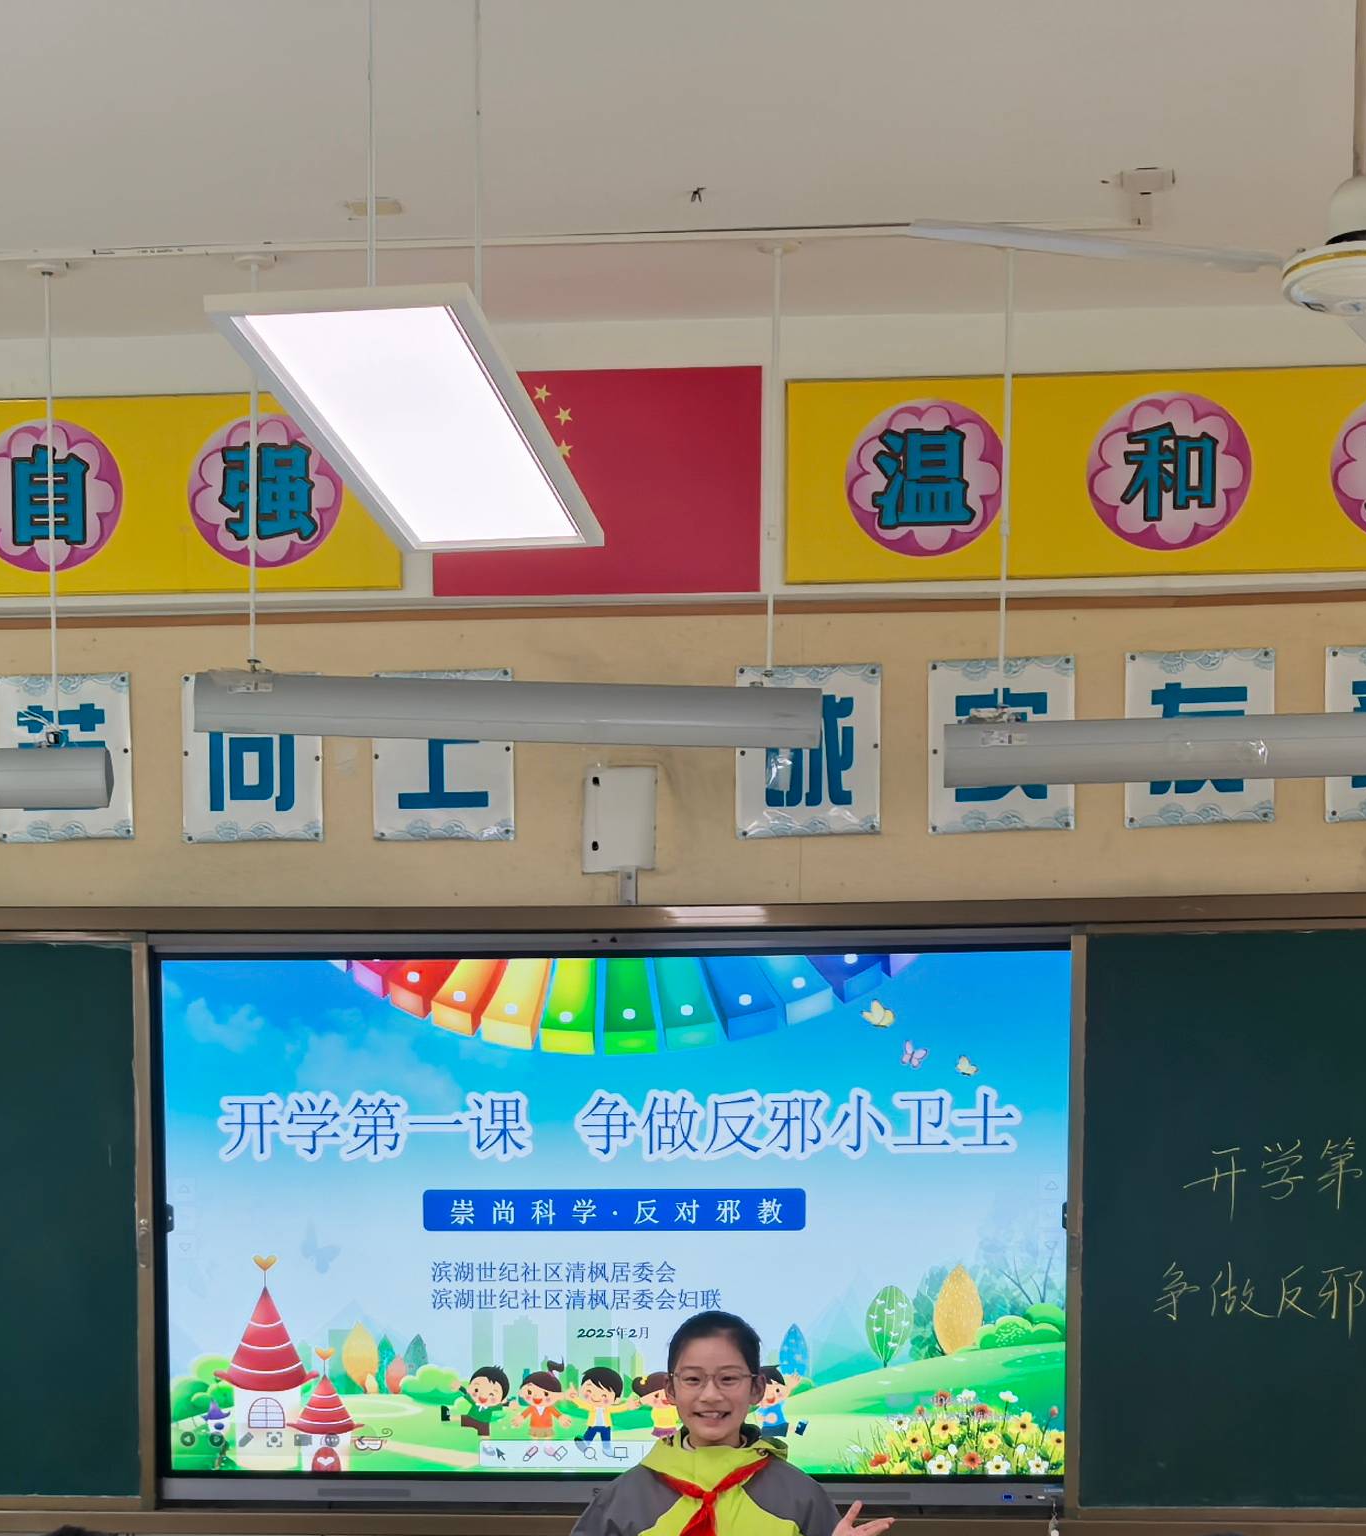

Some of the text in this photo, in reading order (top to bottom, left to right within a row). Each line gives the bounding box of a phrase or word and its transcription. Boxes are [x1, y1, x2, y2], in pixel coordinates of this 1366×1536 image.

[221, 1090, 1017, 1158] 开学第一课 争做反邪小卫士
[431, 1261, 676, 1283] 滨湖世纪社区清枫居委会
[431, 1288, 722, 1311] 滨湖世纪社区清枫居委会妇联
[577, 1325, 650, 1340] 2025年2月
